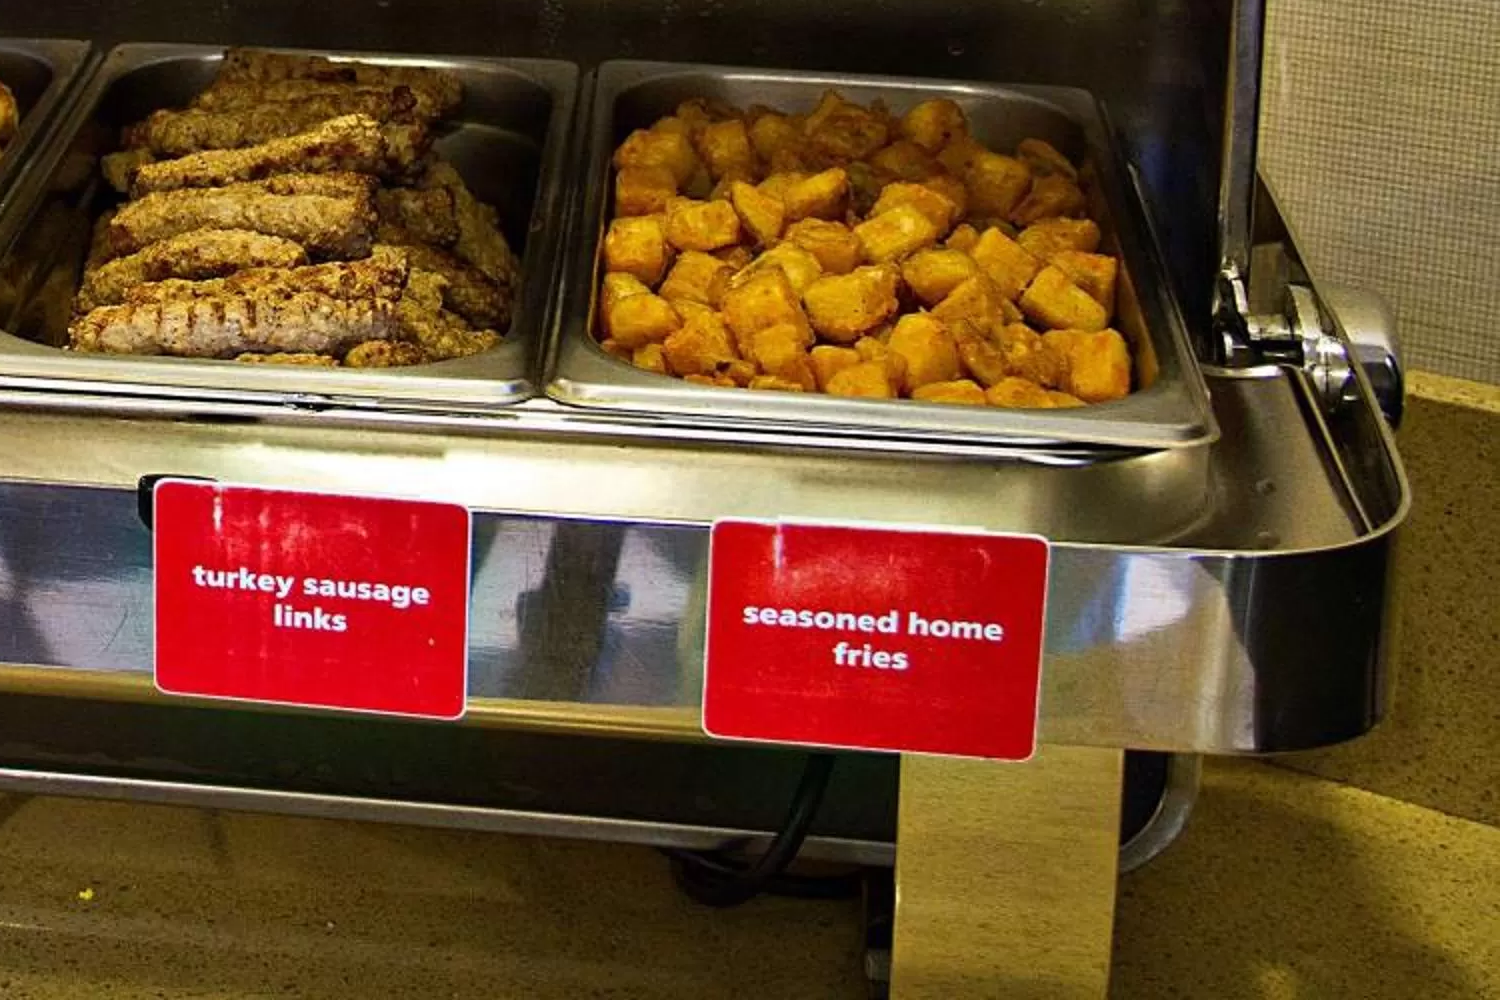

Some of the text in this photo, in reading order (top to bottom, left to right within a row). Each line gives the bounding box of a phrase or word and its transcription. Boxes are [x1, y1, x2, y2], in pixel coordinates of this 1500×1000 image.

[192, 564, 430, 609] turkey sausage
[274, 603, 347, 632] links
[743, 605, 1004, 641] seasoned home
[833, 641, 909, 670] fries
